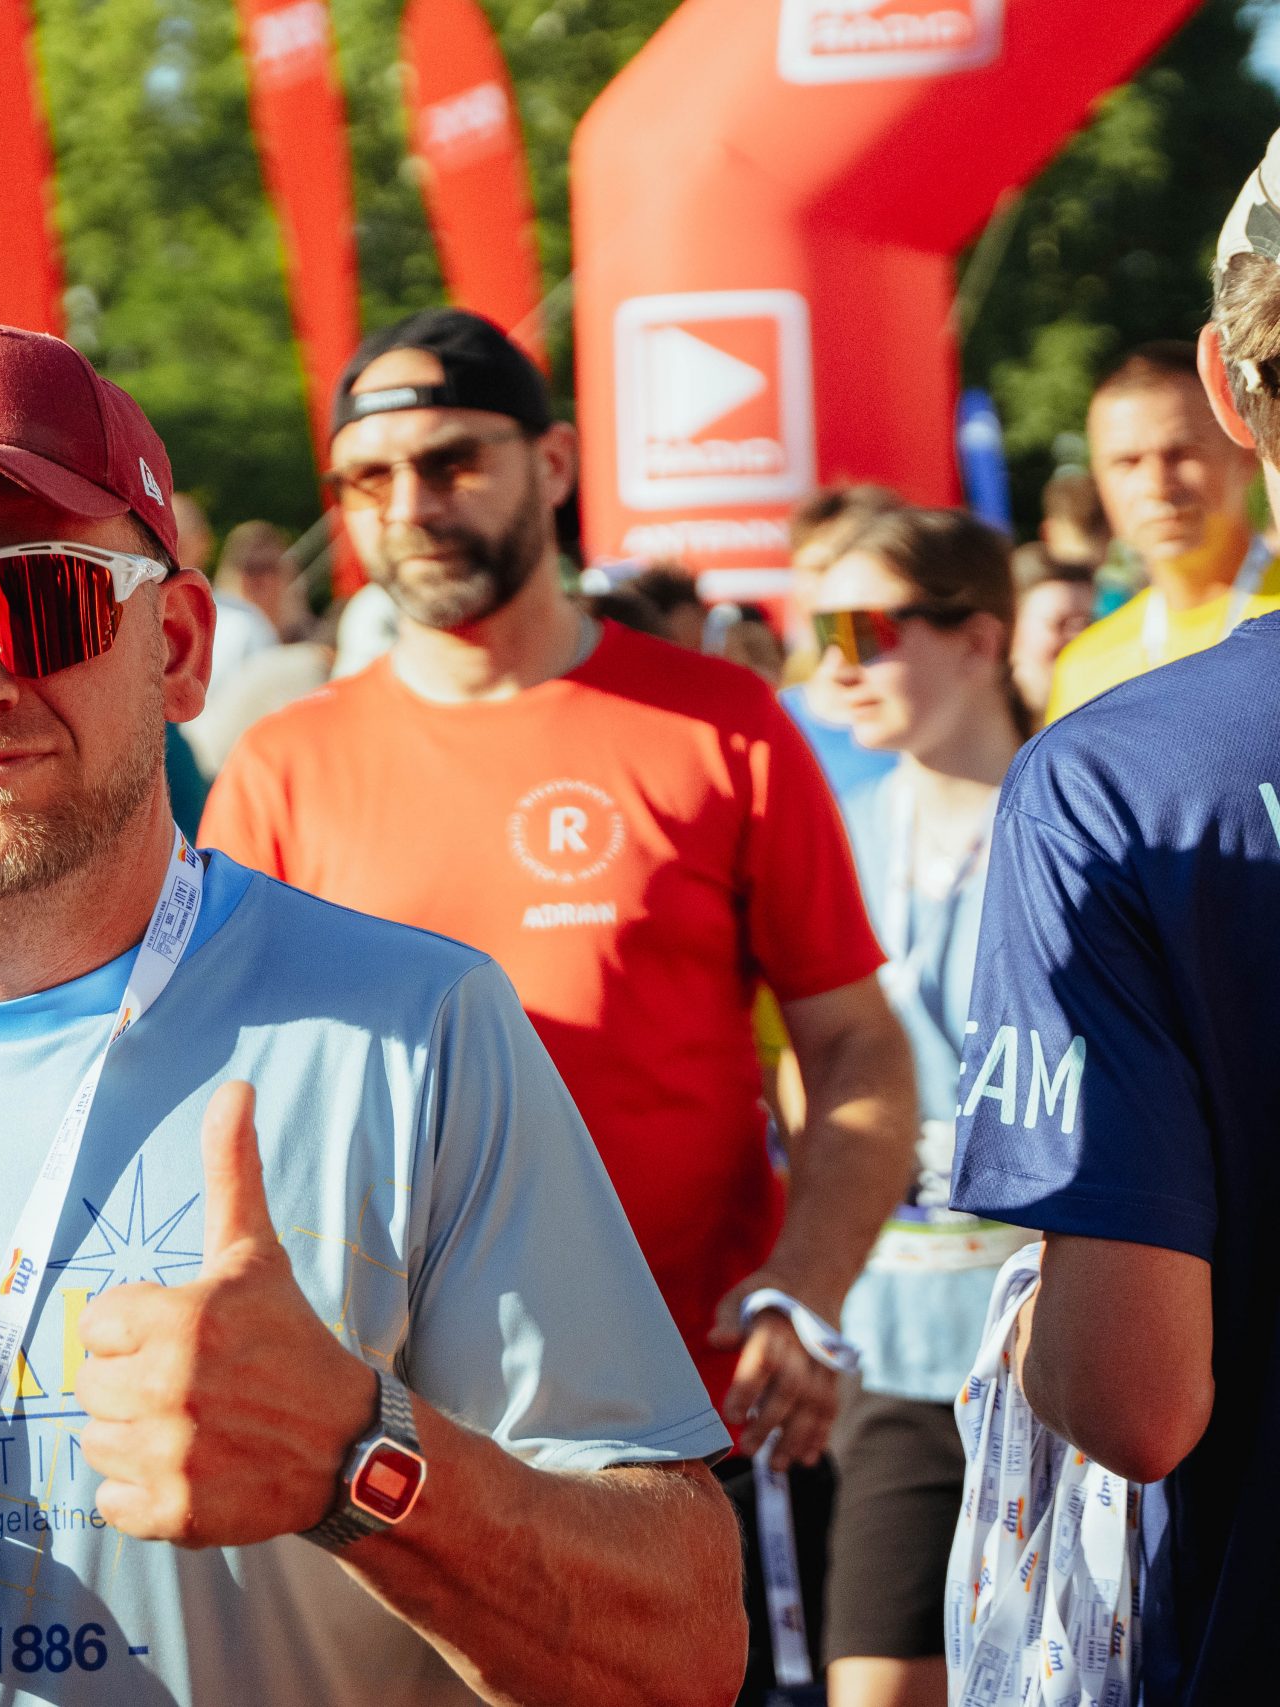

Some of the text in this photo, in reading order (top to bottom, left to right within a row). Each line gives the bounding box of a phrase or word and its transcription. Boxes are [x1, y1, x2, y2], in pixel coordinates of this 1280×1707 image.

[549, 806, 588, 852] R
[174, 881, 188, 907] LAUF
[185, 887, 197, 911] FIRMEN
[523, 902, 617, 928] ADRIAN
[955, 1020, 1086, 1134] AM
[11, 1257, 38, 1295] dm
[0, 1328, 18, 1365] FIRMEN
[1003, 1501, 1019, 1533] dm
[1049, 1640, 1065, 1672] dm
